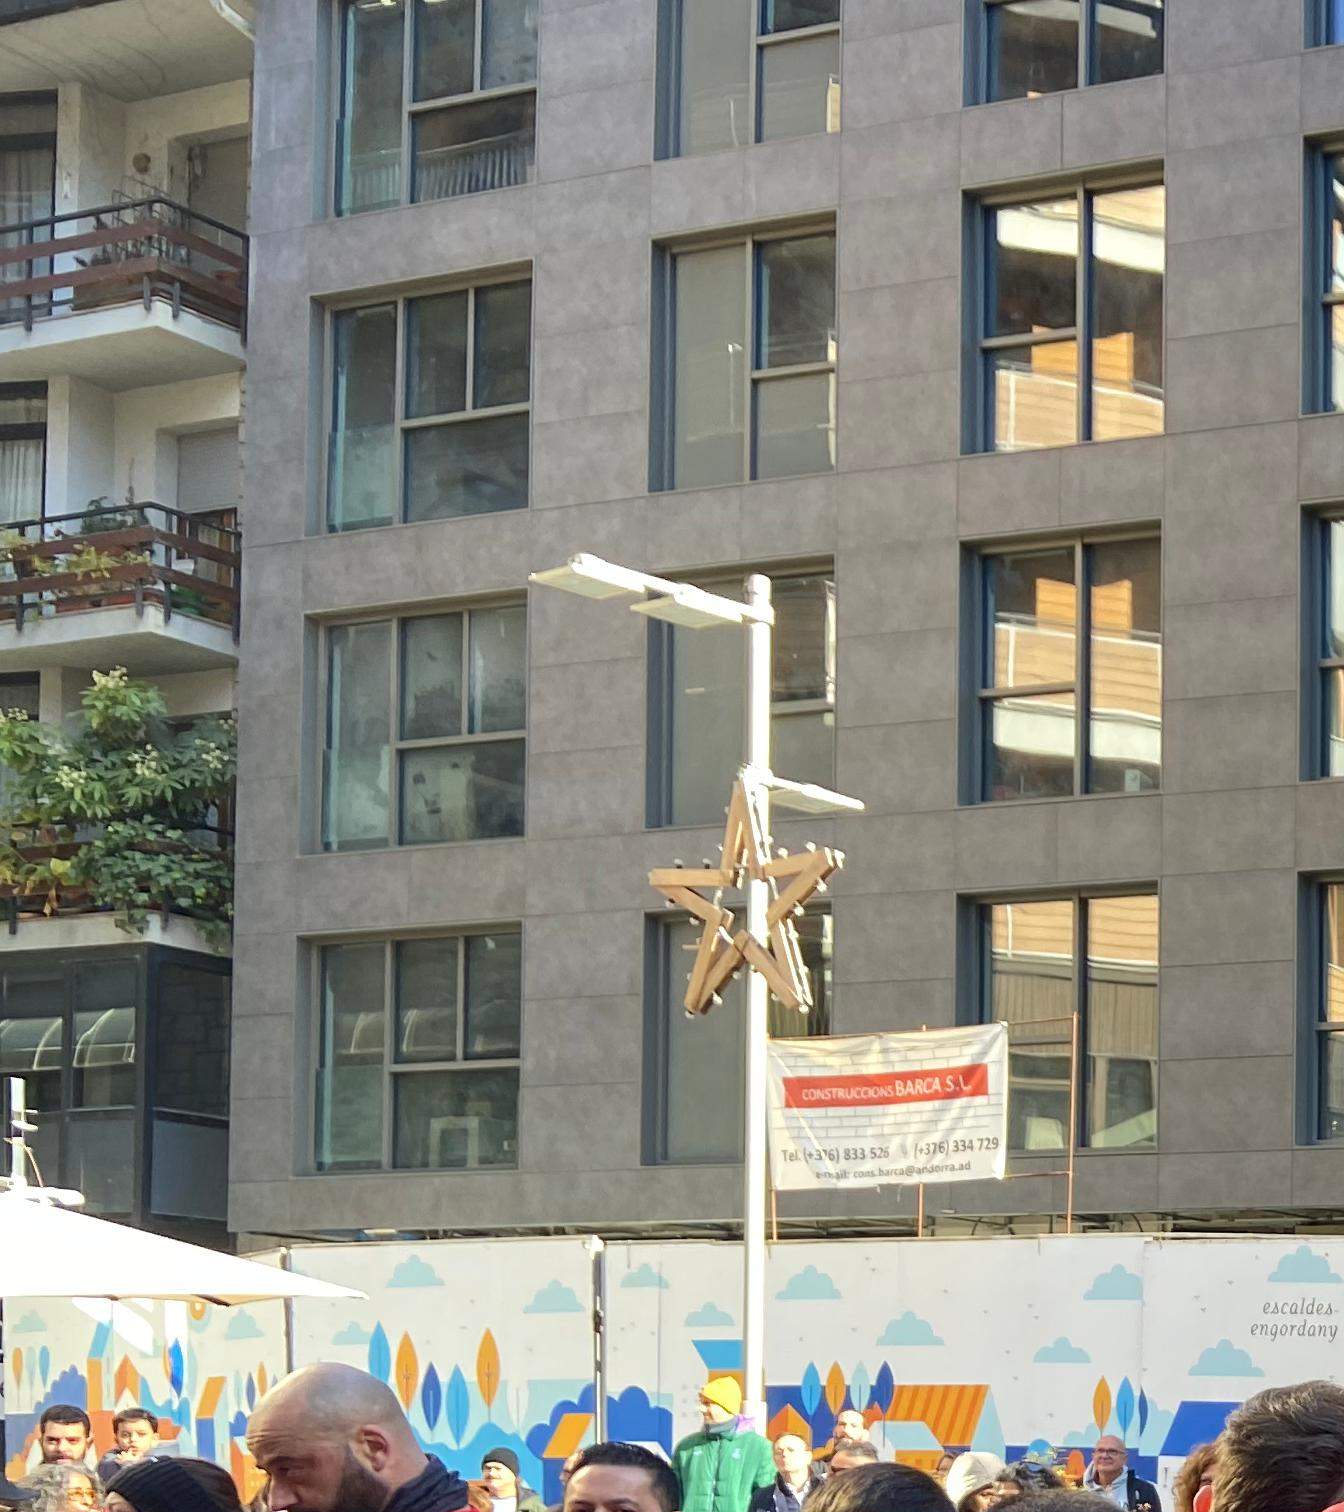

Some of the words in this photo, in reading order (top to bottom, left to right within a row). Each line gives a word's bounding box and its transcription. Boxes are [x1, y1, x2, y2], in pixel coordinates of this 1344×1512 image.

[802, 1086, 894, 1100] CONSTRUCCIONS
[895, 1077, 941, 1096] BARCA
[843, 1147, 866, 1160] 833
[913, 1140, 949, 1159] (+376)
[952, 1139, 974, 1152] 334
[977, 1136, 999, 1151] 729
[1250, 1320, 1339, 1343] engordany
